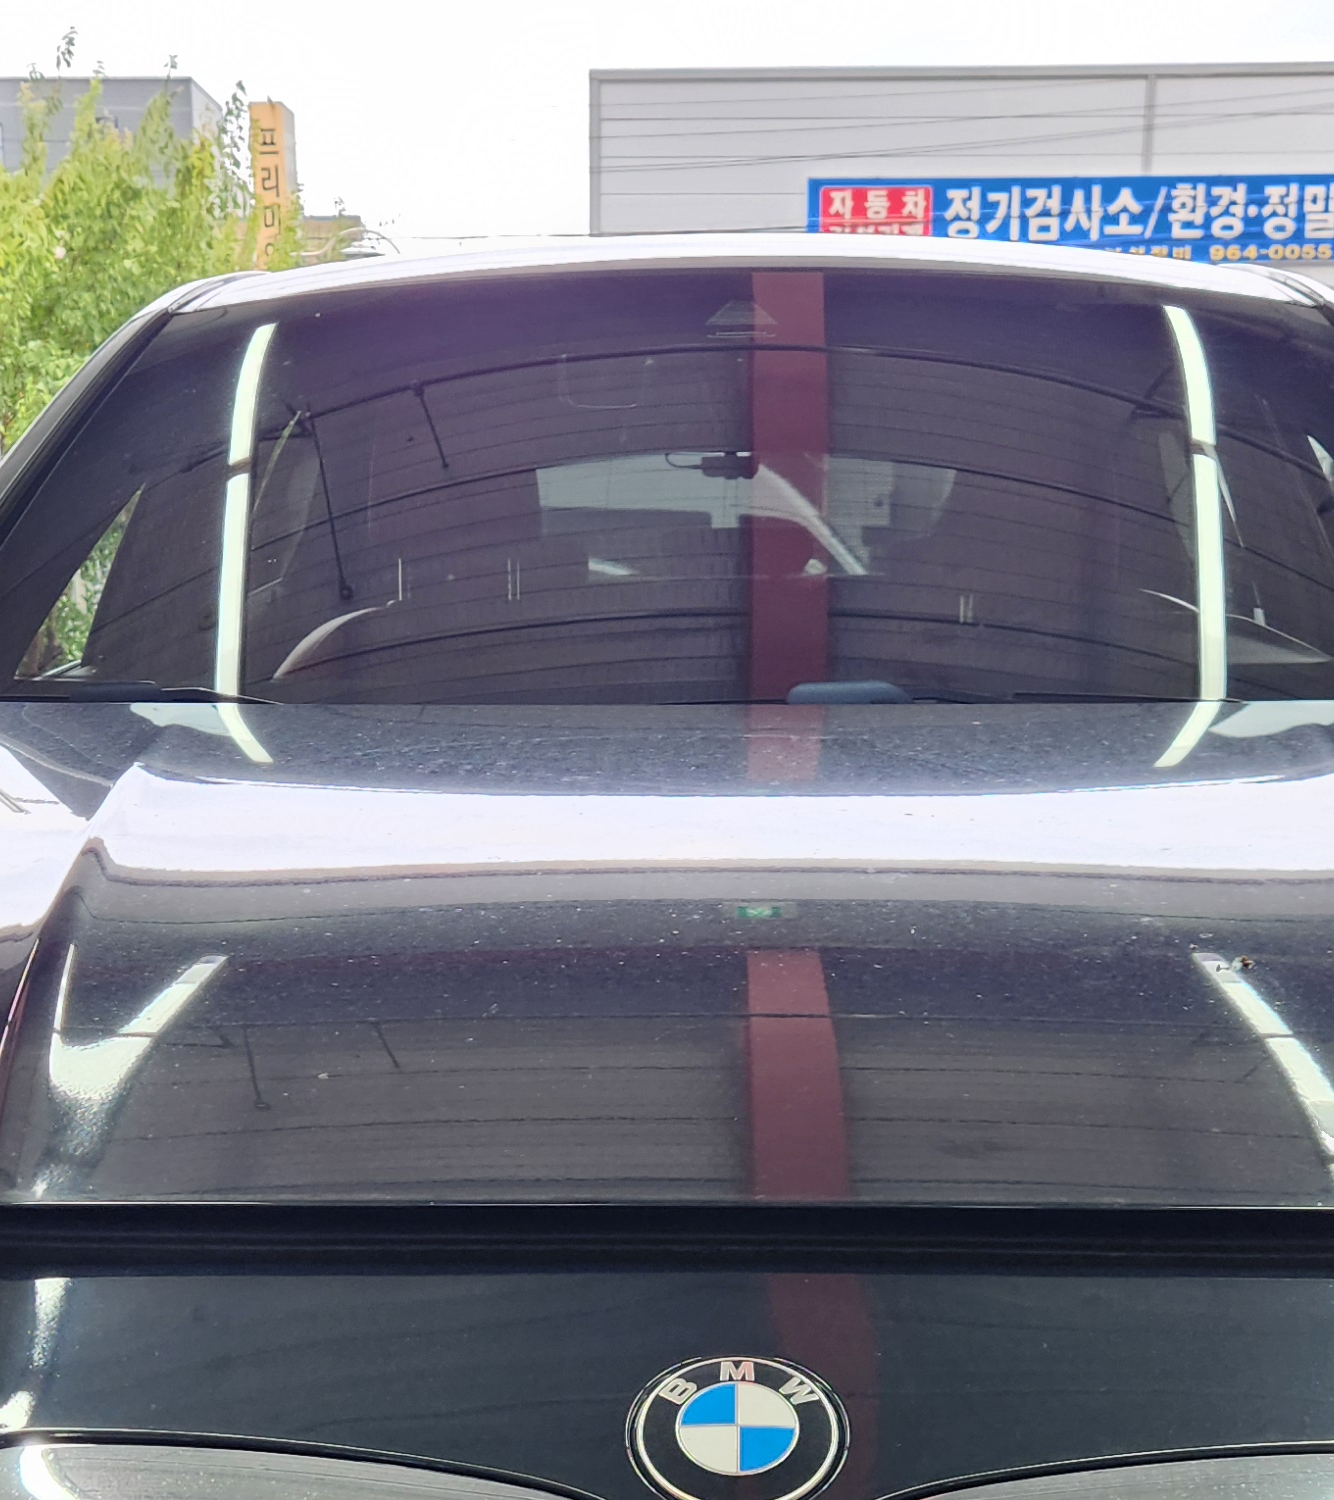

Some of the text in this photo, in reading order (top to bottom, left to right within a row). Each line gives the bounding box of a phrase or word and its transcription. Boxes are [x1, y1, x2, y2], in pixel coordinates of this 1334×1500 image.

[259, 128, 281, 256] 프리미
[828, 188, 927, 220] 자동차
[1209, 243, 1333, 261] 964-0055
[657, 1361, 820, 1405] BMW
